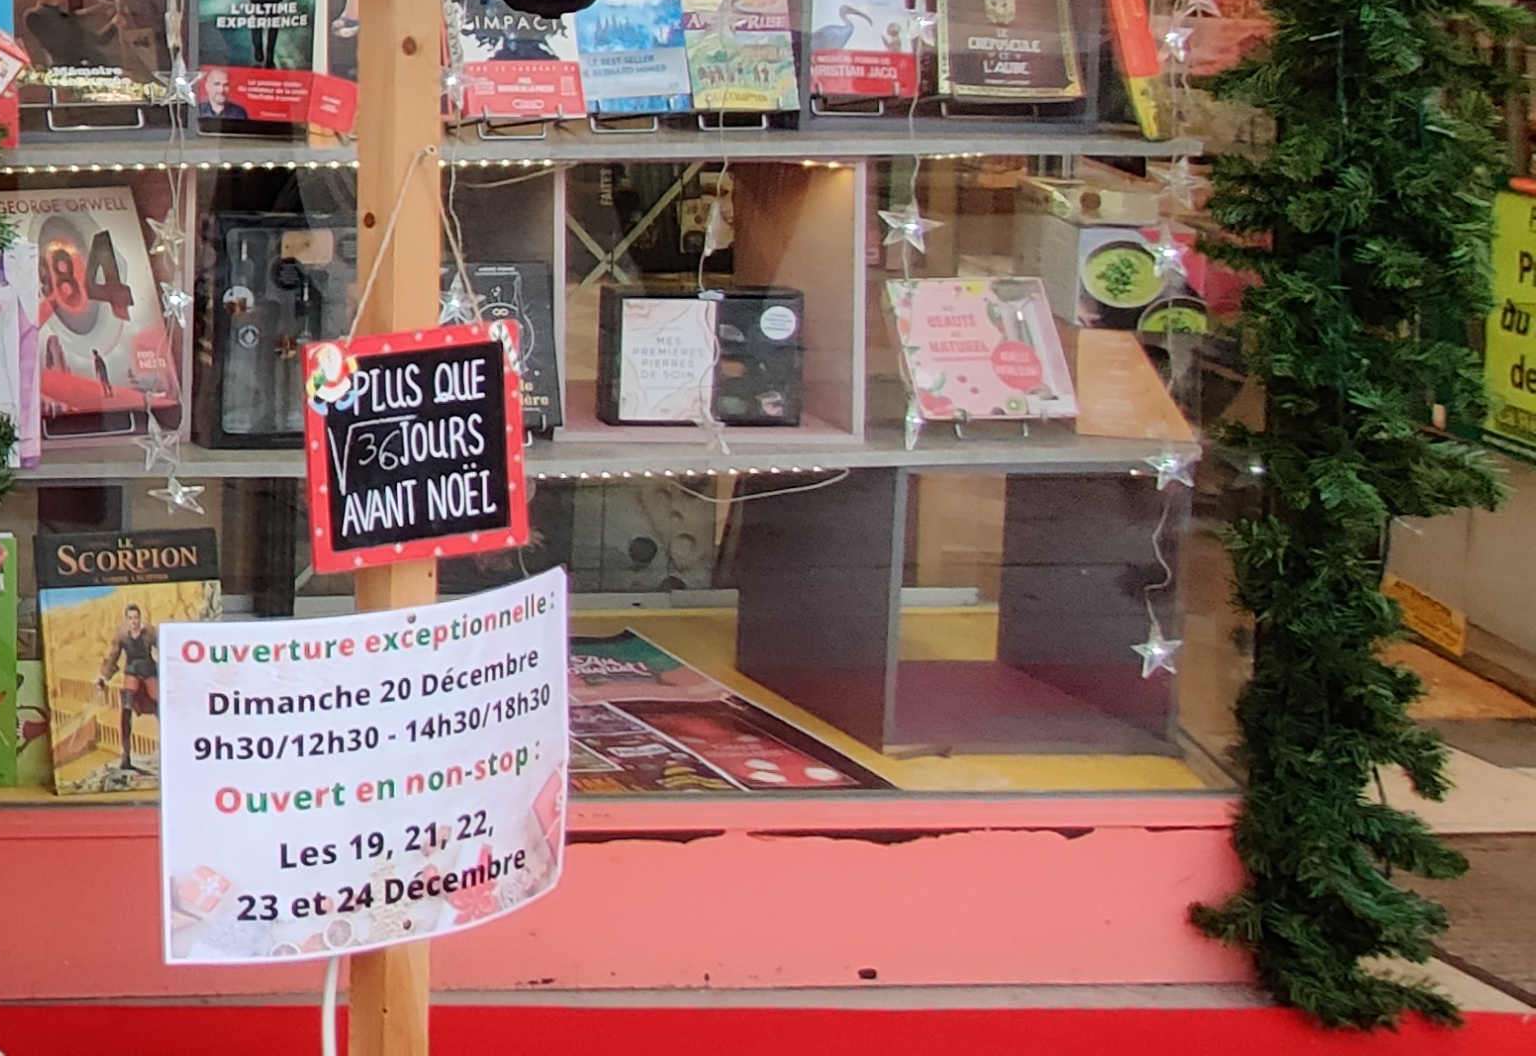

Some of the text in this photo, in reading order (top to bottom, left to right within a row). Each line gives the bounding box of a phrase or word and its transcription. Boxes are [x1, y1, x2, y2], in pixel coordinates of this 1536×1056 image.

[230, 1, 298, 15] L'ULTIME
[216, 14, 308, 29] EXPÉRIENCE
[473, 14, 558, 32] IMPACT
[746, 14, 788, 30] RUSE
[996, 27, 1007, 38] LE
[968, 36, 1042, 52] CRÉPUSCULE
[52, 65, 123, 76] Mémoire
[867, 67, 899, 80] JACQ
[983, 59, 1030, 75] L'AUBE
[65, 196, 128, 213] ORWELL
[926, 313, 978, 328] BEAUTÉ
[656, 336, 682, 345] MES
[928, 340, 990, 354] NATUREL
[631, 345, 705, 358] PREMIÈRES
[640, 358, 696, 369] PIERRES
[640, 370, 696, 380] DE SOIN
[352, 363, 423, 416] PLUS
[433, 358, 486, 404] QUE
[399, 413, 485, 466] JOURS
[341, 462, 498, 538] AVANT NOËL
[117, 537, 134, 549] LE
[56, 544, 198, 576] SCORPION
[181, 633, 356, 665] Ouverture
[207, 684, 372, 716] Dimanche
[379, 676, 412, 704] 20
[421, 649, 540, 697] Décembre
[193, 725, 380, 762] 9h30/12h30
[405, 683, 551, 743] 14h30/18h30
[214, 781, 346, 815] Ouvert
[355, 776, 396, 802] en
[405, 743, 529, 796] non-stop
[279, 809, 494, 869] Les 19, 21, 22,
[236, 848, 527, 921] 23 et 24 Décembre
